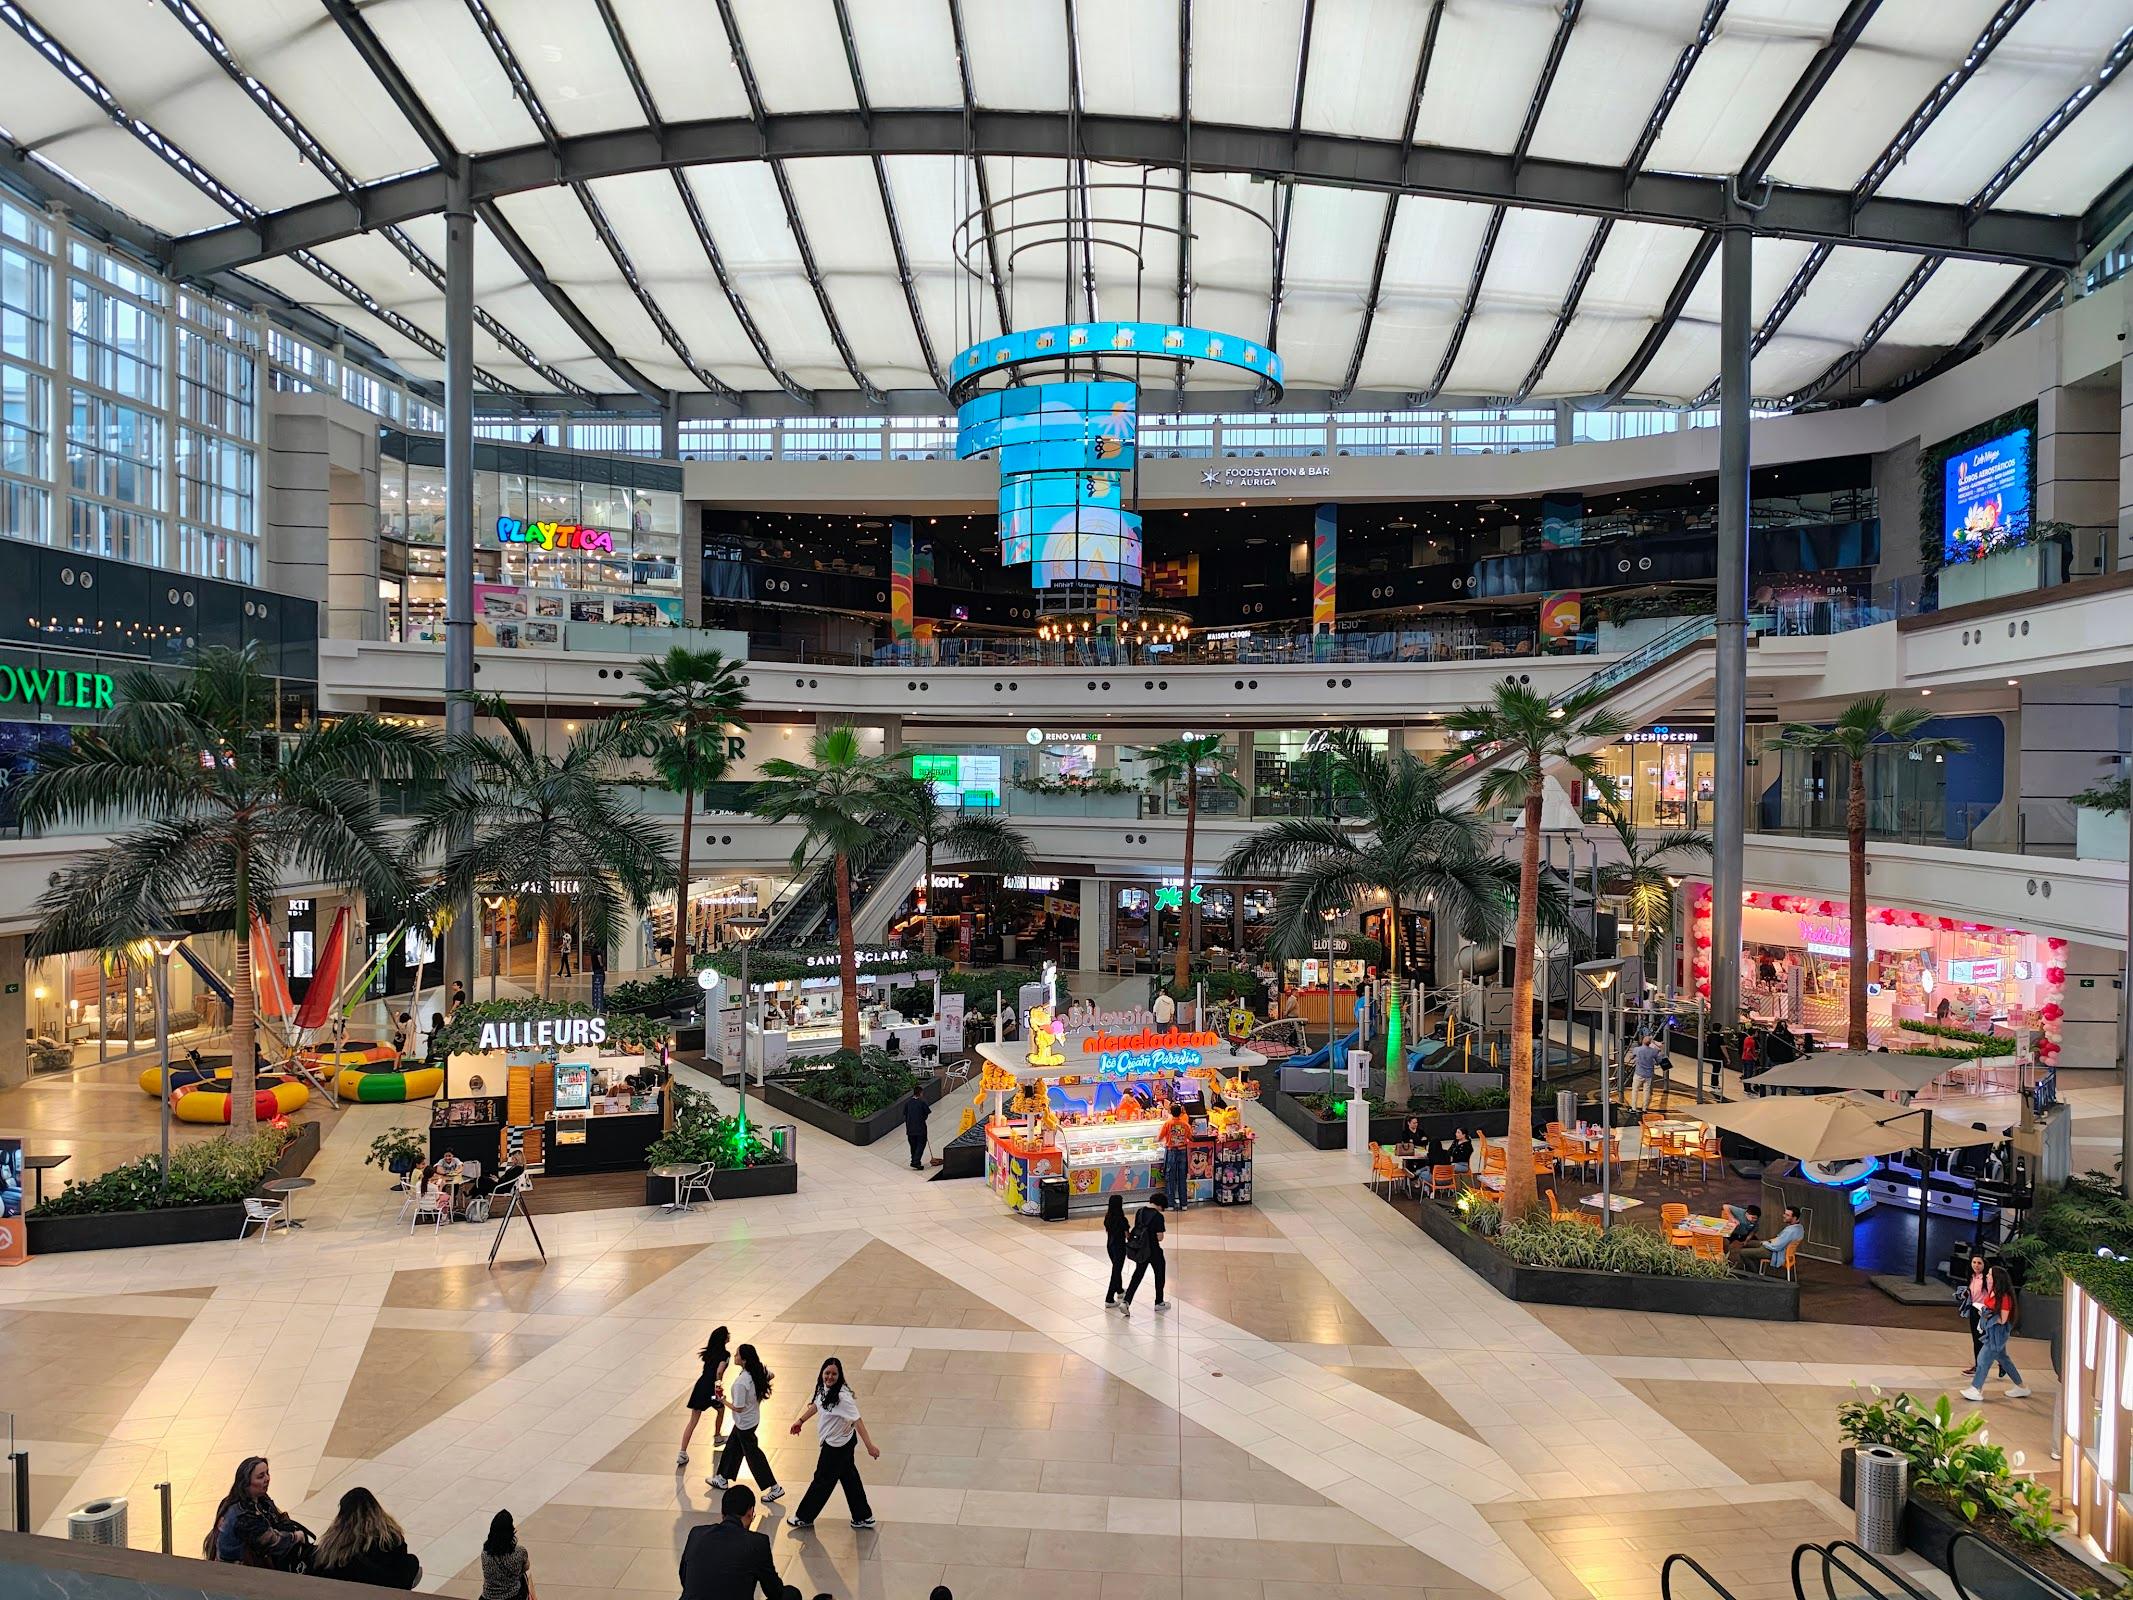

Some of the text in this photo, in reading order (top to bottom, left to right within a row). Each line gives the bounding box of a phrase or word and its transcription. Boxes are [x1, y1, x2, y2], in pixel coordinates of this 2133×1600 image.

[1225, 467, 1330, 477] FOODSTATION & BAR
[497, 516, 613, 553] PLAYTICA
[1207, 631, 1230, 641] MAISON
[1045, 732, 1069, 741] RENO
[1624, 733, 1698, 741] OCCHIOCCHI
[1313, 939, 1347, 951] ELOERO
[807, 950, 907, 967] SANT CLARA
[479, 1017, 606, 1049] AILLEURS
[1083, 1026, 1218, 1053] nickelodeon
[1101, 1049, 1200, 1073] Ice Cream Paradise
